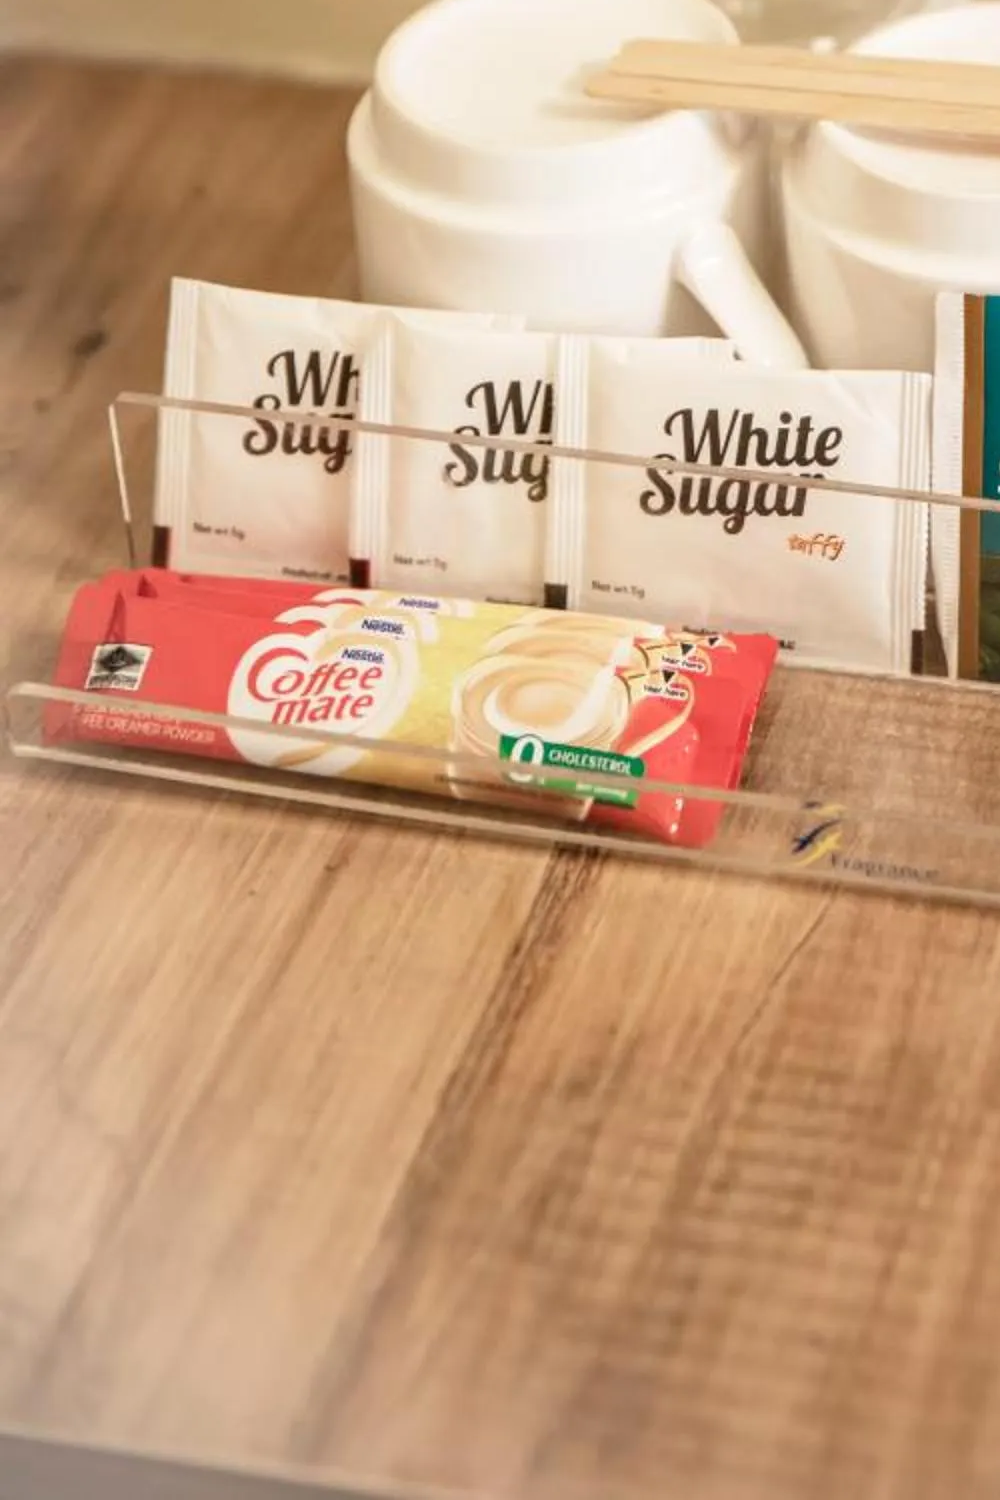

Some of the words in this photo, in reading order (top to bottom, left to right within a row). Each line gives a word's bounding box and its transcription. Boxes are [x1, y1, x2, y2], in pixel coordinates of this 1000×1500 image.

[243, 394, 353, 474] Sug
[444, 425, 552, 502] Sug
[664, 408, 842, 467] White
[639, 453, 827, 534] Sugar
[247, 647, 383, 702] Coffee
[272, 693, 374, 725] mate
